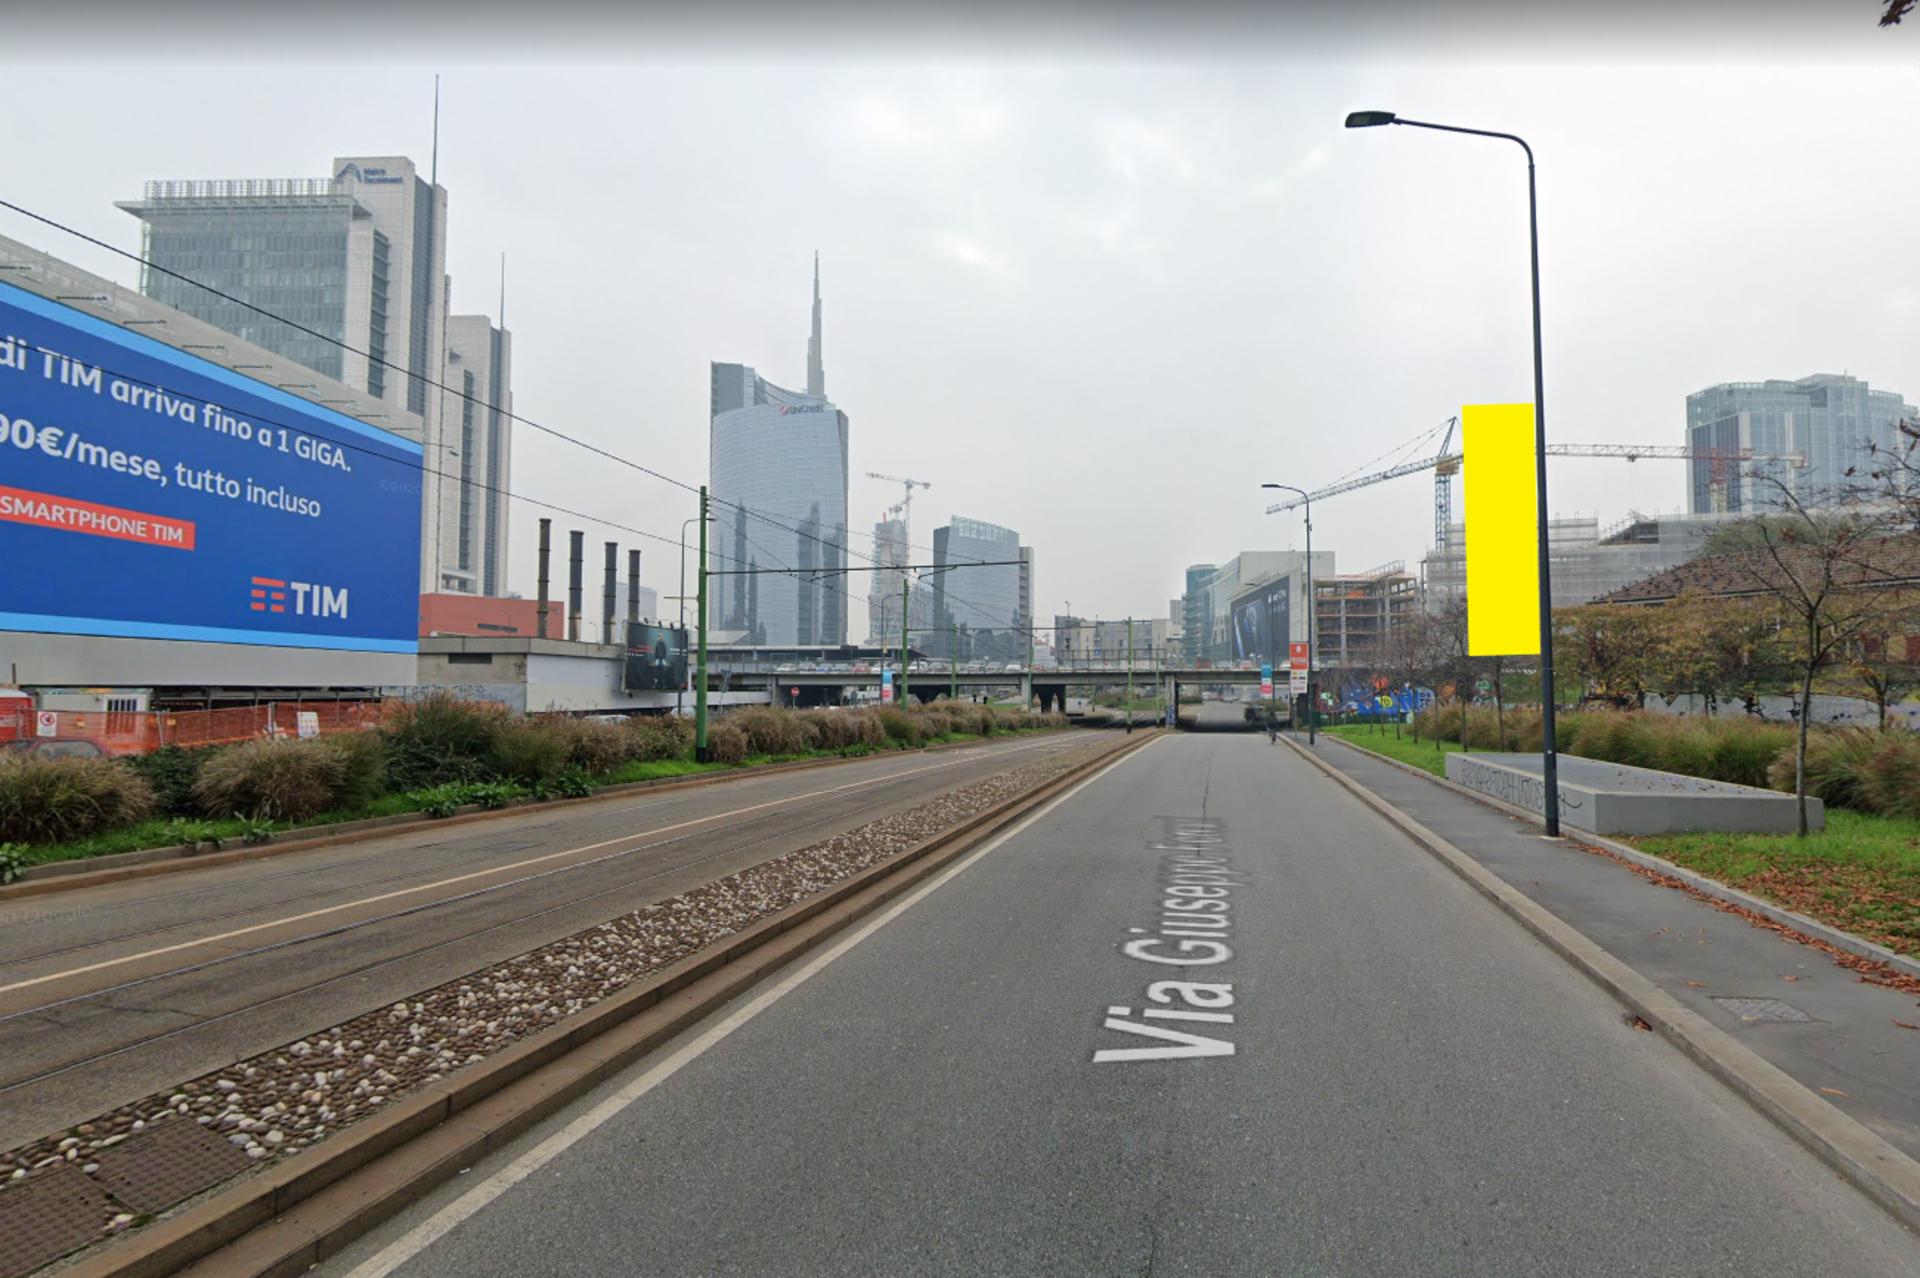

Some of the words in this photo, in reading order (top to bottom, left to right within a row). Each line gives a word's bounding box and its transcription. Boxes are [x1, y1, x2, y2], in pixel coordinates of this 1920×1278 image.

[0, 335, 26, 370] di
[36, 346, 102, 394] TIM
[111, 379, 196, 423] arriva
[203, 403, 252, 440] fino
[258, 428, 272, 447] a
[278, 429, 289, 453] 1
[295, 436, 352, 472] GIGA.
[175, 462, 241, 498] tutto
[246, 477, 321, 517] incluso
[0, 496, 147, 538] SMARTPHONE
[151, 523, 184, 543] TIM
[290, 582, 348, 619] TIM
